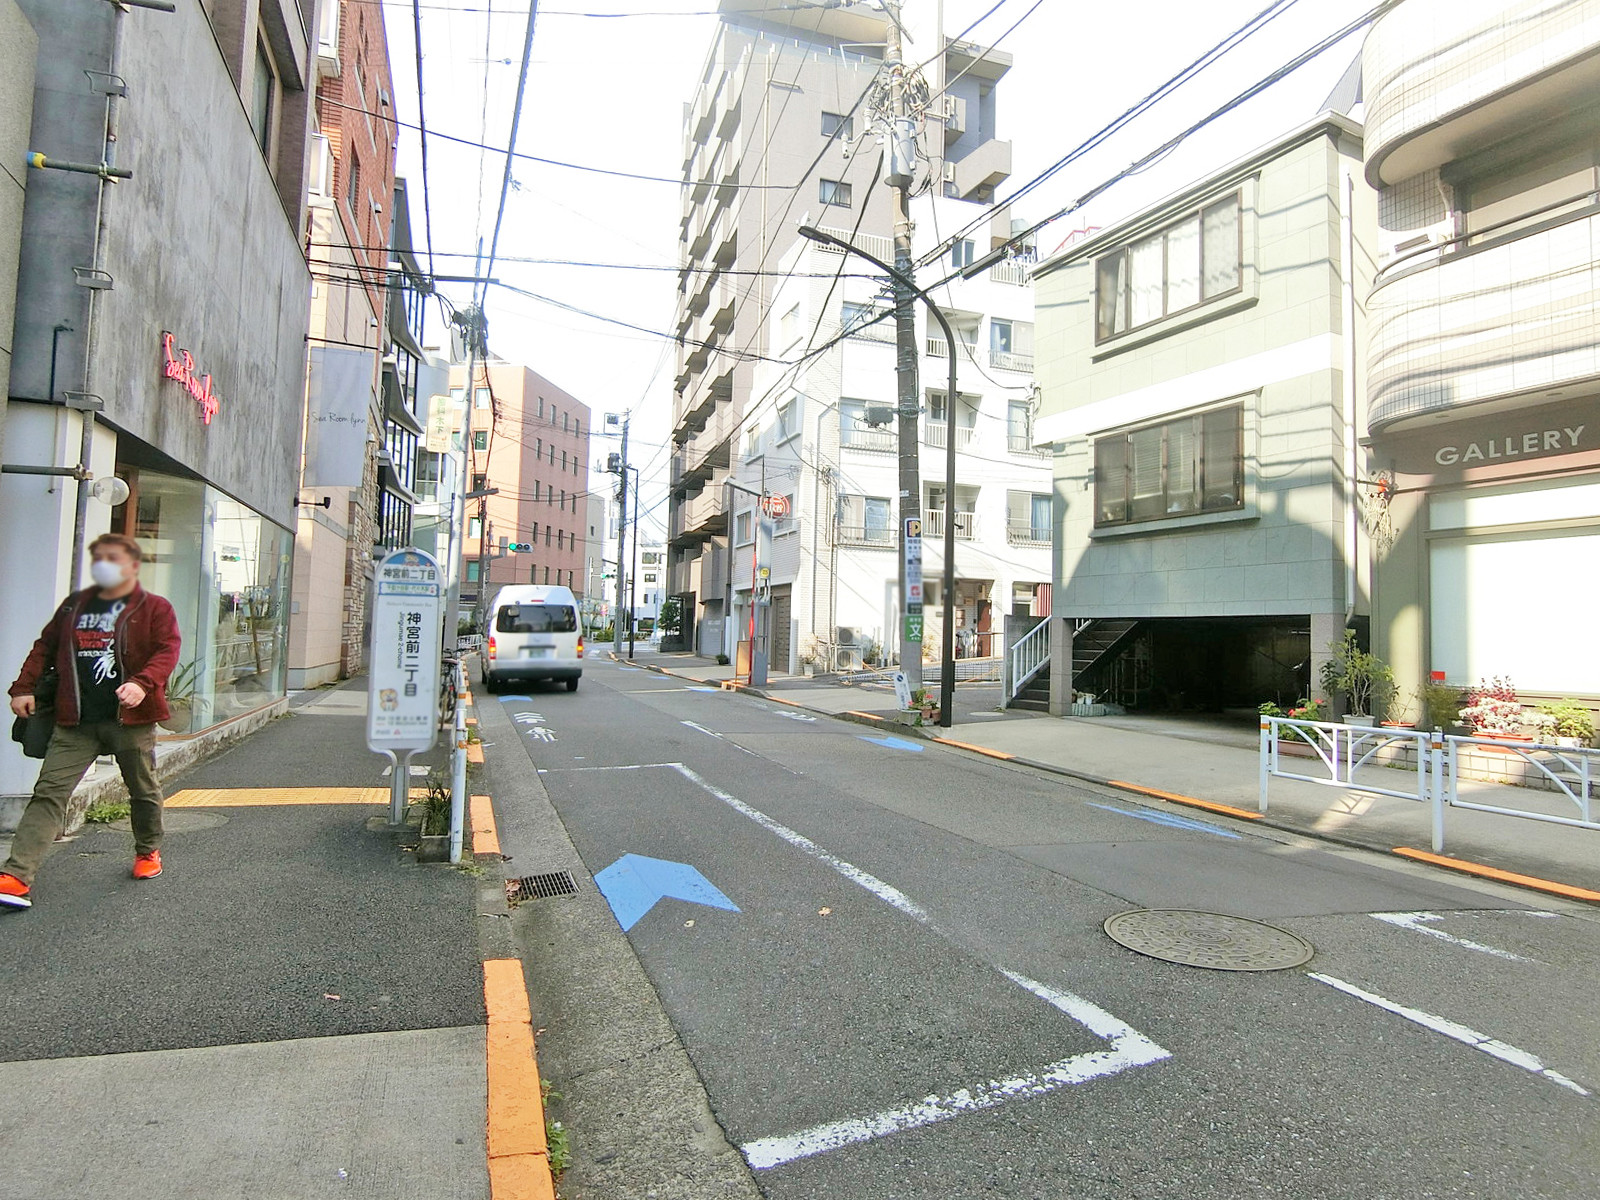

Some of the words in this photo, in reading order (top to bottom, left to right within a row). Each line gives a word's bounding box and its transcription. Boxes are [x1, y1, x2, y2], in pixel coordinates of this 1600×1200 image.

[312, 411, 327, 424] Sea
[328, 411, 348, 423] Room
[1435, 425, 1585, 465] GALLERY
[383, 567, 436, 581] 神宮前二丁目
[909, 622, 922, 637] 文
[403, 612, 422, 697] 神宮前二丁目
